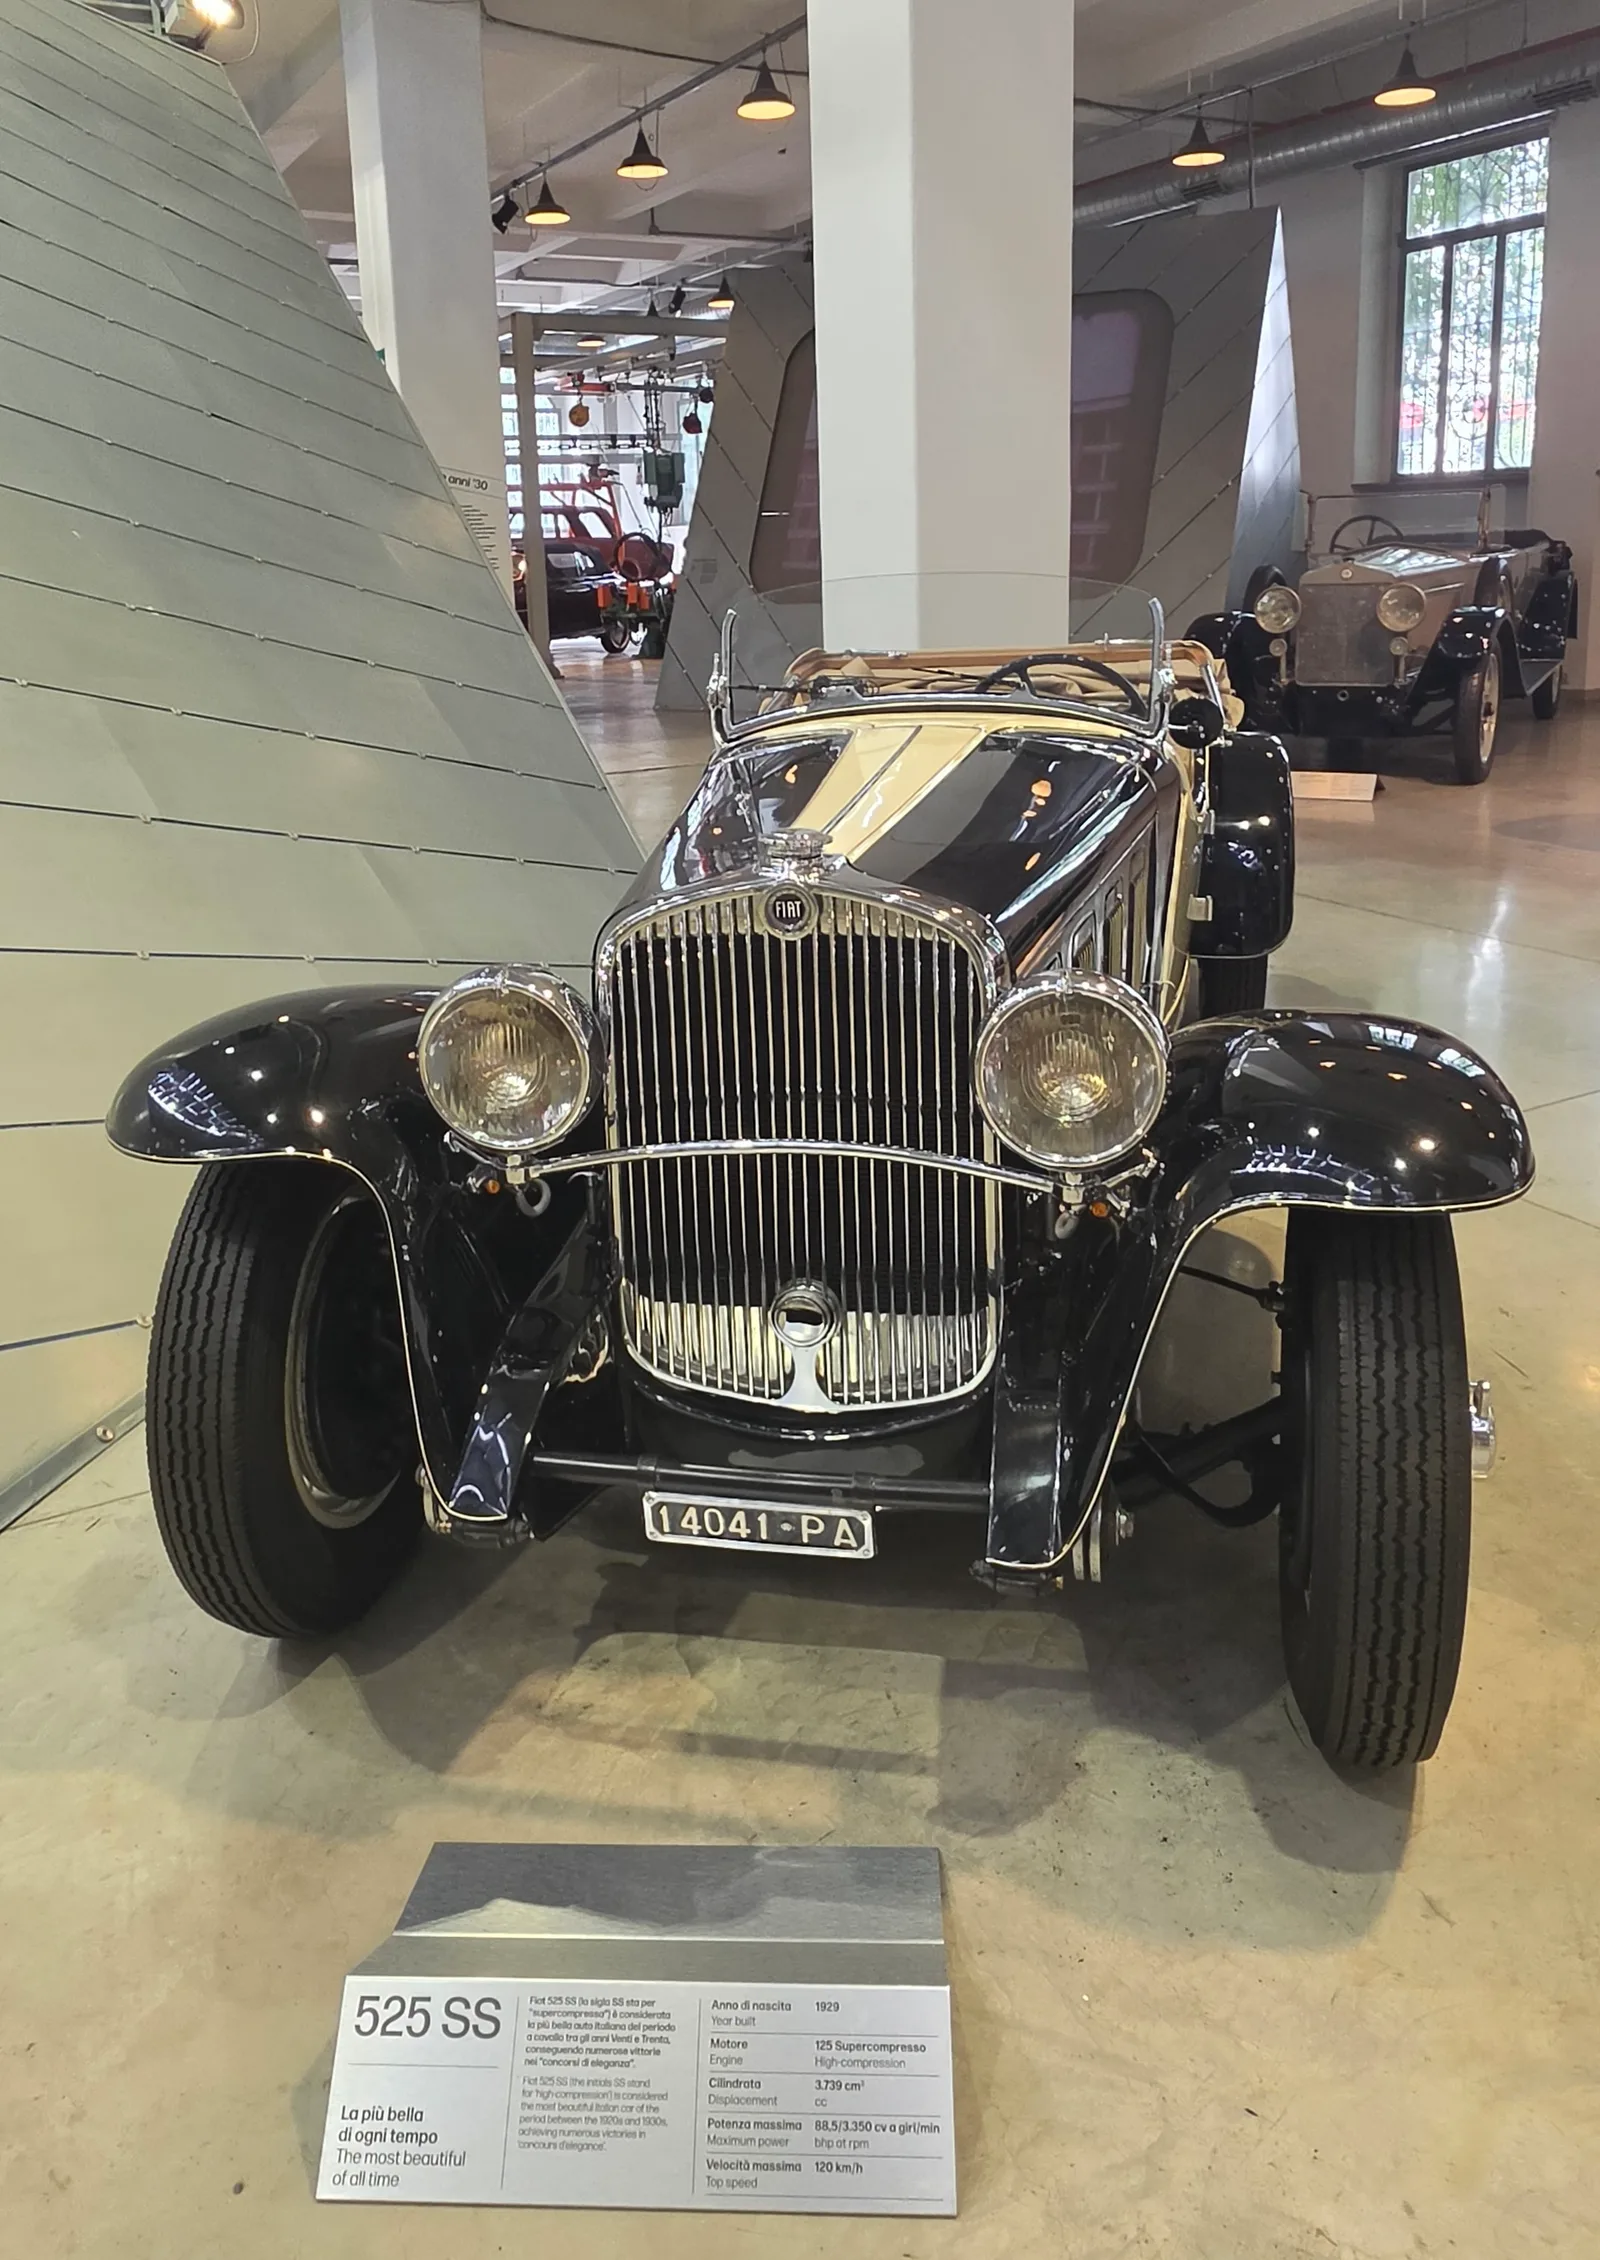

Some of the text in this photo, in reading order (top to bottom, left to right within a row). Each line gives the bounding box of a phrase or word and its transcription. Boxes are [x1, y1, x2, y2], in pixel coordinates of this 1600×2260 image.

[448, 475, 470, 487] anni
[776, 901, 801, 918] FIAT
[712, 2001, 791, 2011] Anno di nascita
[816, 2002, 840, 2012] 1929
[354, 1995, 501, 2039] 525 SS
[712, 2016, 756, 2026] Year built
[537, 2021, 549, 2031] più
[552, 2021, 572, 2029] bella
[595, 2022, 626, 2031] italiana
[628, 2023, 640, 2031] del
[643, 2024, 675, 2032] periodo
[710, 2039, 748, 2049] Motore
[816, 2041, 926, 2053] 125 Supercompresso
[526, 2046, 584, 2056] conseguendo
[630, 2048, 661, 2056] vittorie
[710, 2056, 743, 2066] Engine
[815, 2057, 905, 2070] High-compression
[709, 2078, 761, 2089] Cilindrata
[815, 2080, 842, 2090] 3.739
[708, 2094, 777, 2107] Displacement
[815, 2099, 827, 2107] cc
[341, 2106, 423, 2124] La più bella
[708, 2118, 802, 2131] Potenza massima
[875, 2124, 887, 2132] cv
[890, 2124, 896, 2132] a
[899, 2123, 940, 2135] giri/min
[339, 2127, 438, 2146] di ogni tempo
[707, 2135, 789, 2149] Maximum power
[815, 2138, 869, 2150] bhp at rpm
[337, 2149, 466, 2166] The most beautiful
[707, 2159, 801, 2172] Velocità massima
[815, 2162, 863, 2174] 120 km/h
[332, 2170, 399, 2187] of all time
[706, 2176, 757, 2189] Top speed
